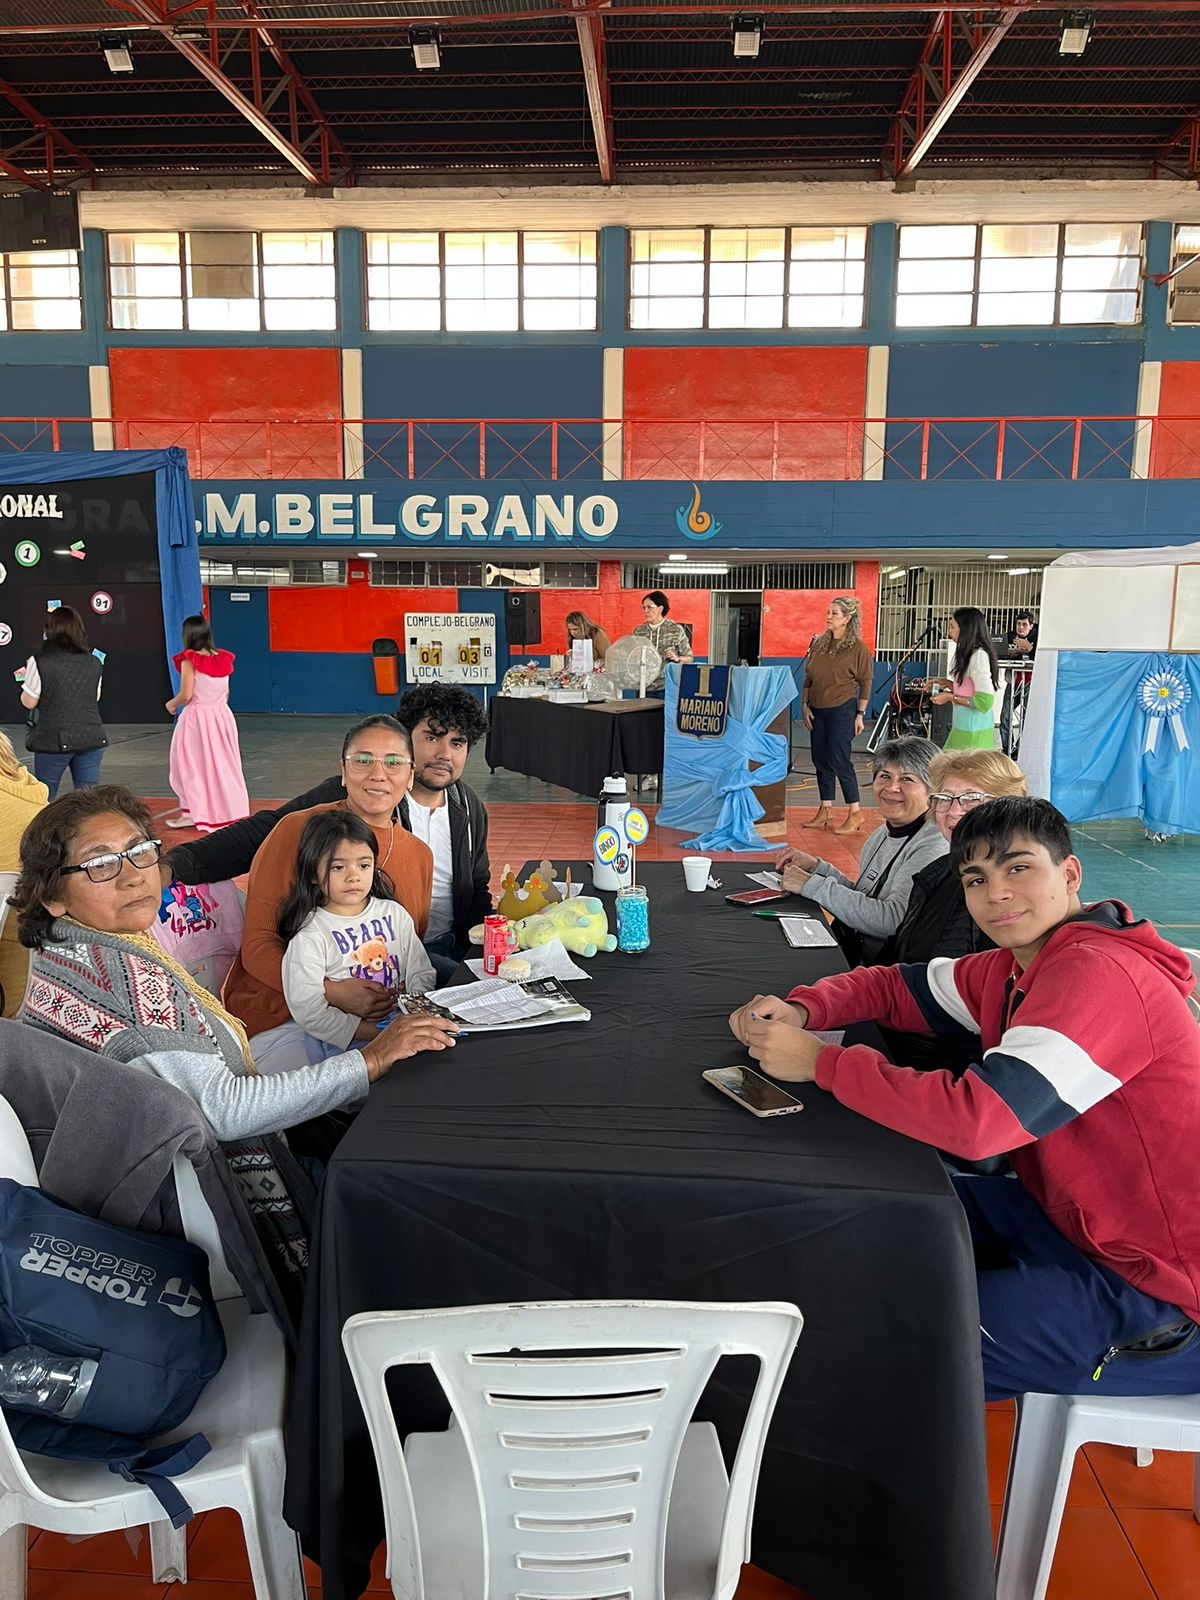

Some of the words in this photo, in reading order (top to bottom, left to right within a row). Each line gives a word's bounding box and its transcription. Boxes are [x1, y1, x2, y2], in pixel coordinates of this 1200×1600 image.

[0, 494, 63, 518] ONAL
[23, 547, 31, 560] 1
[95, 598, 109, 609] 91
[412, 667, 444, 678] LOCAL
[680, 698, 724, 716] MARIANO
[681, 714, 720, 732] MORENO
[598, 836, 616, 855] BINGO
[331, 915, 396, 955] BEARY
[30, 1233, 157, 1286] TOPPER
[20, 1247, 148, 1307] TOPPER
